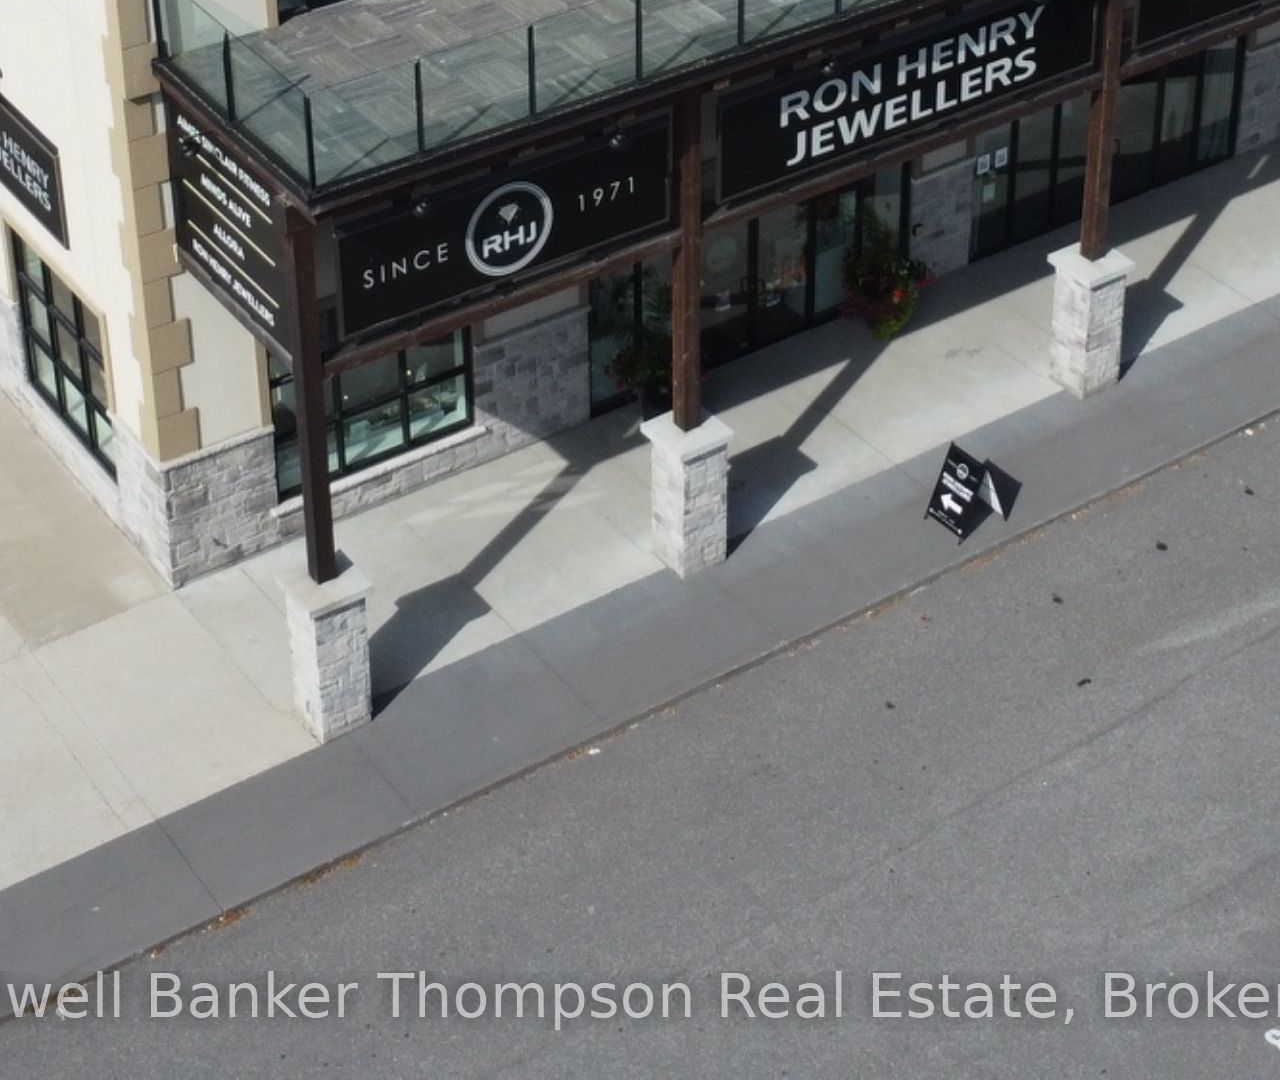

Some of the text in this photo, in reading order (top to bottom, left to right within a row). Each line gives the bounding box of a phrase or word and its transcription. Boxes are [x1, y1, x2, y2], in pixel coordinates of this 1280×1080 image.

[778, 5, 1046, 129] RON HENRY
[785, 47, 1038, 167] JEWELLERS
[2, 130, 50, 190] HENRY
[213, 223, 246, 261] ALLORA
[362, 176, 636, 290] SINCE RHJ 1971
[232, 279, 275, 327] JEWELLERS
